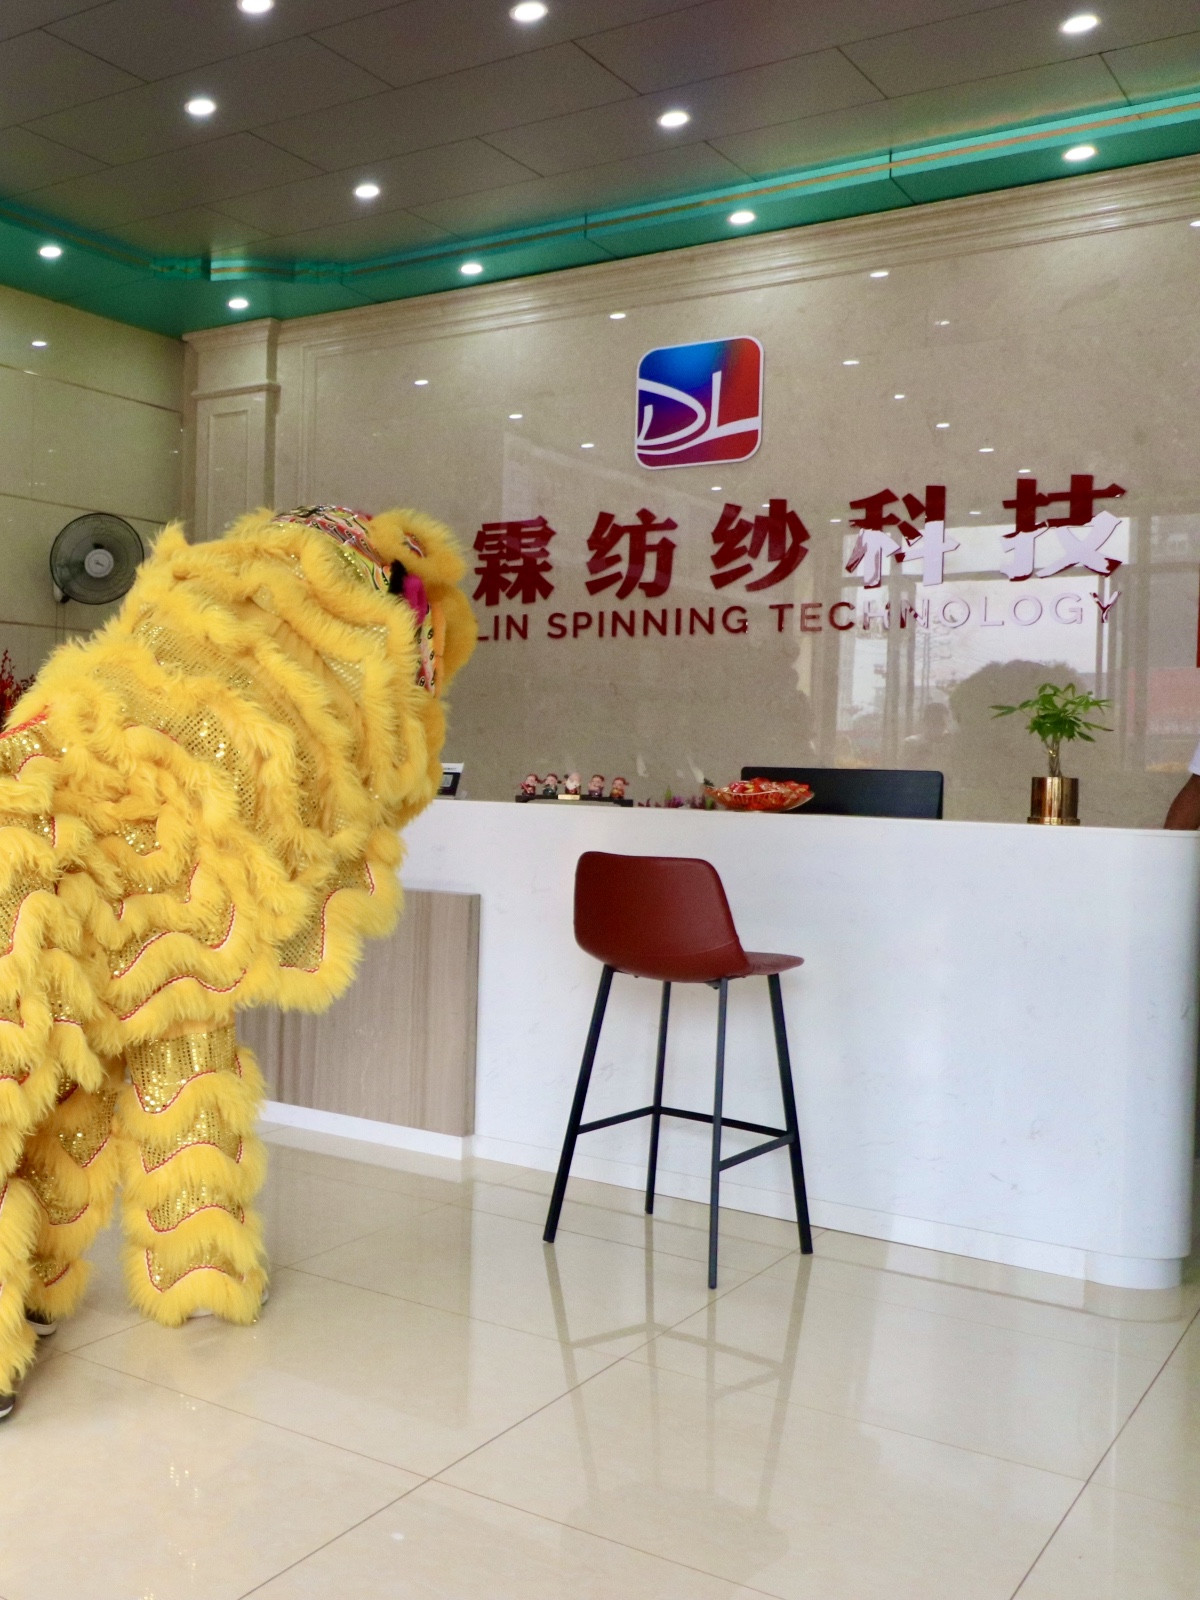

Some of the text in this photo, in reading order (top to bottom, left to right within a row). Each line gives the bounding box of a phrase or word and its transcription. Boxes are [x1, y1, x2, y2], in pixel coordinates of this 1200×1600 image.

[471, 474, 1127, 606] 霖纺纱科技
[547, 606, 749, 639] SPINNING
[769, 591, 1121, 633] TECHNOLOGY
